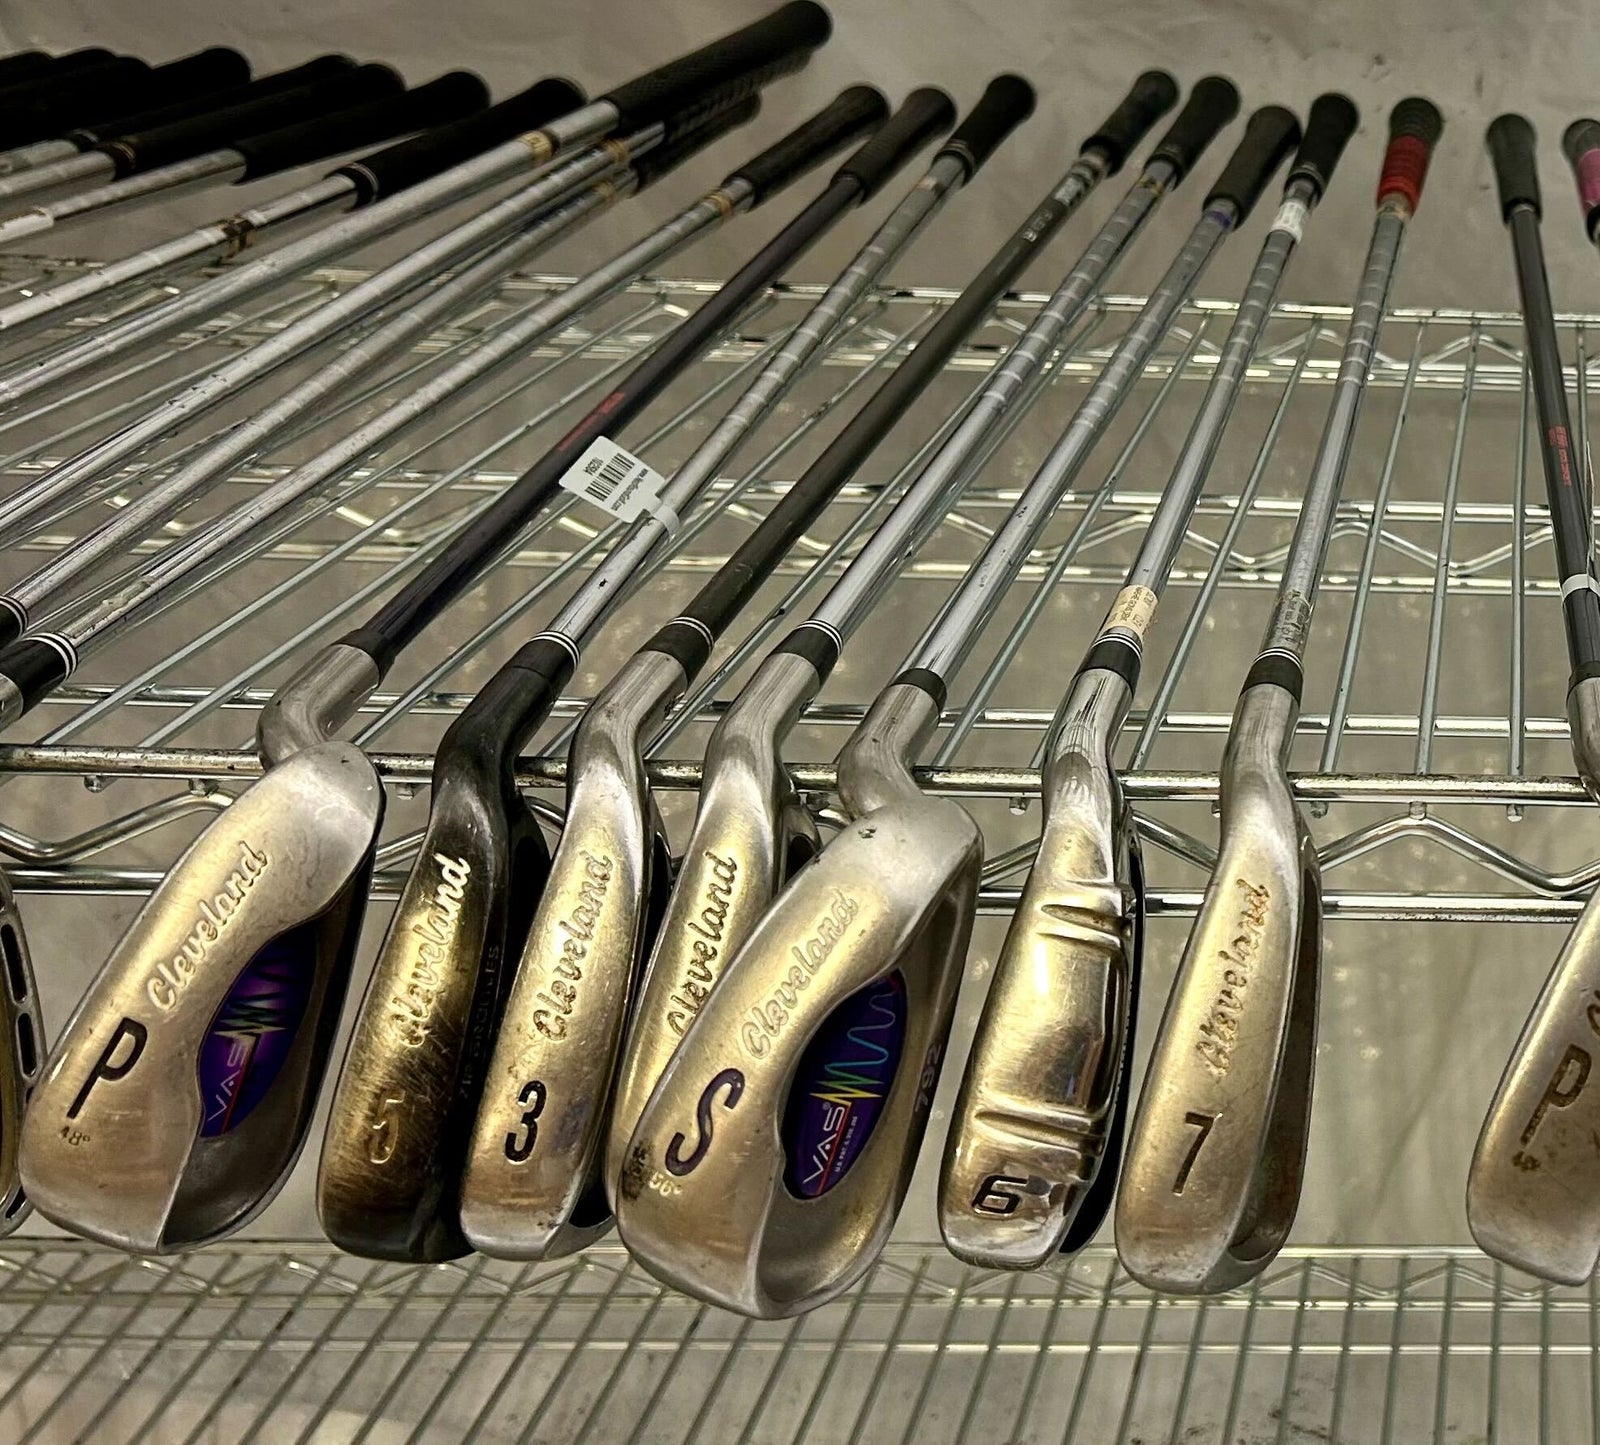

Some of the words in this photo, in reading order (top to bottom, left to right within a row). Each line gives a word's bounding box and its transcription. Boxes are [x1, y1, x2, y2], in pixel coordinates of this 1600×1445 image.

[147, 839, 271, 1010] Cleveland
[387, 852, 472, 1049] Cleveland
[532, 850, 614, 1043] Cleveland
[741, 886, 859, 1061] Cleveland
[1195, 879, 1271, 1077] Cleveland
[65, 1016, 149, 1121] P
[503, 1080, 548, 1164] 3
[664, 1068, 746, 1177] S
[1520, 1044, 1593, 1147] P
[970, 1173, 1022, 1215] 6
[1170, 1111, 1221, 1196] 7
